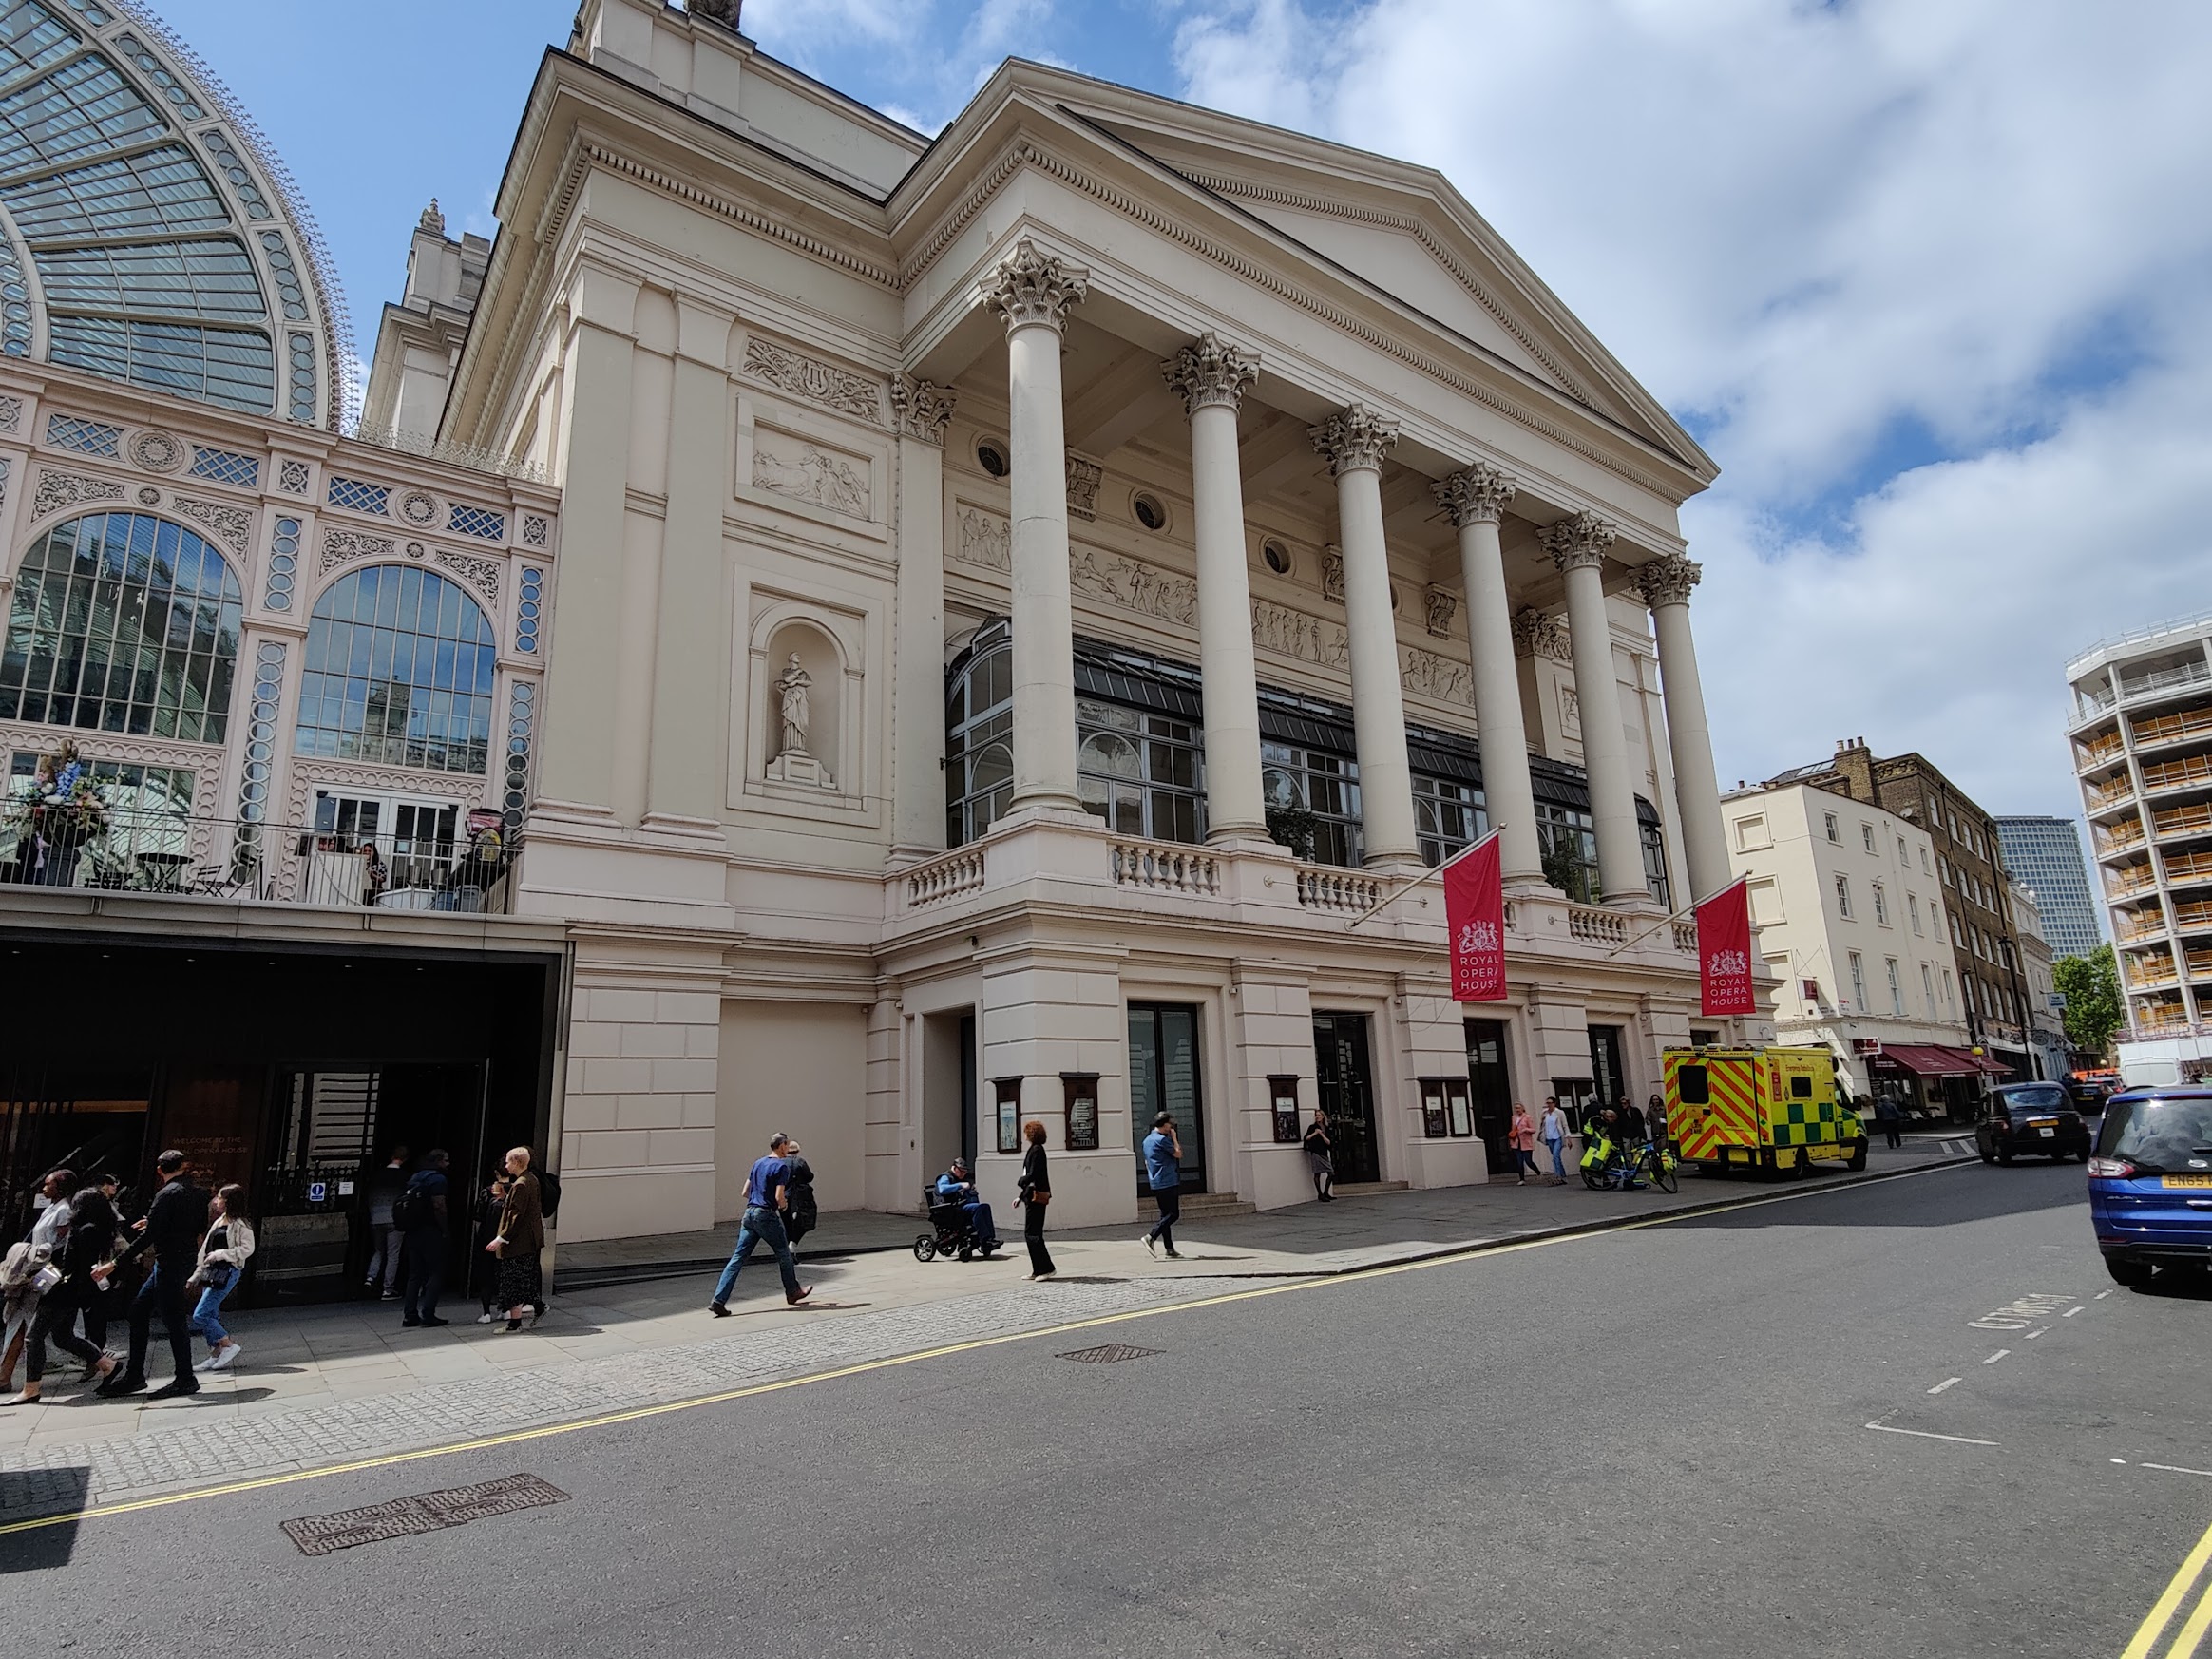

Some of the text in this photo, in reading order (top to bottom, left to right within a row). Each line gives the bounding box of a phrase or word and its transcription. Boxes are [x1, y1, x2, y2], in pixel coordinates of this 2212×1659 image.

[1459, 954, 1499, 966] ROYAL
[1710, 977, 1746, 987] ROYAL
[1710, 986, 1747, 997] OPERA
[1710, 996, 1747, 1006] HOUSE
[173, 1136, 213, 1145] WELCOME
[2168, 1175, 2204, 1186] EN65
